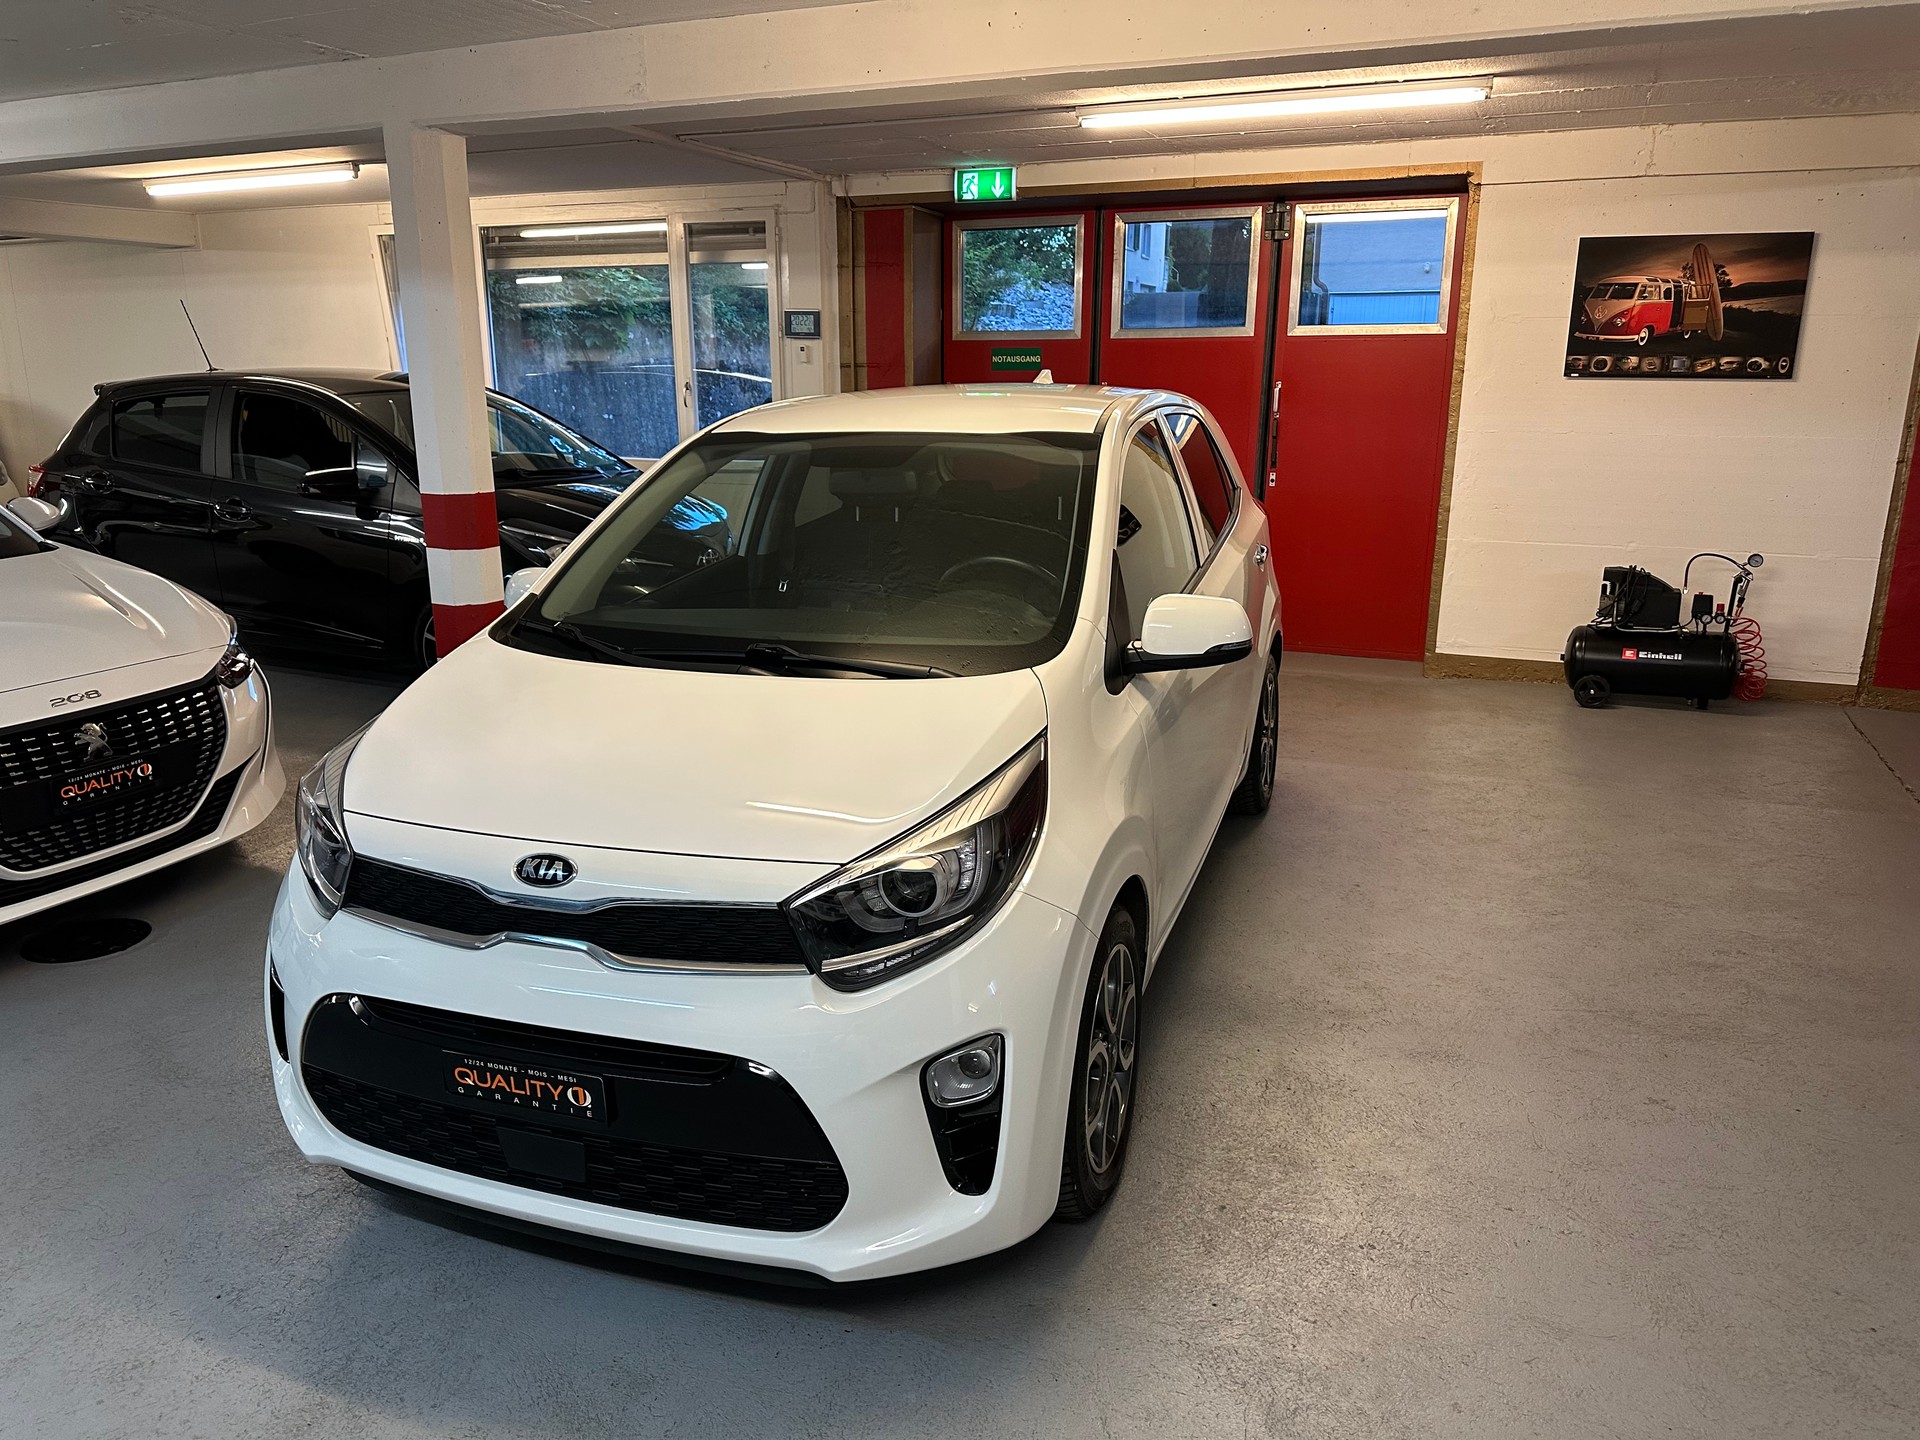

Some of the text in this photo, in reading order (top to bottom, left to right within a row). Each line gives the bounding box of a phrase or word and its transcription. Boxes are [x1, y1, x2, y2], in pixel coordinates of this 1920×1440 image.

[992, 355, 1041, 363] NOTAUSGANG
[1638, 651, 1682, 660] Einhell
[49, 689, 102, 708] 208
[60, 767, 135, 798] QUALITY
[84, 769, 106, 778] MONATE
[62, 775, 153, 806] GARANTIE
[521, 857, 570, 882] KIA
[464, 1058, 485, 1067] 12/24
[487, 1062, 518, 1073] MONATE
[528, 1069, 548, 1078] MOIS
[557, 1074, 577, 1083] MESI
[454, 1067, 564, 1101] QUALITY
[457, 1086, 593, 1118] GARANTIE
